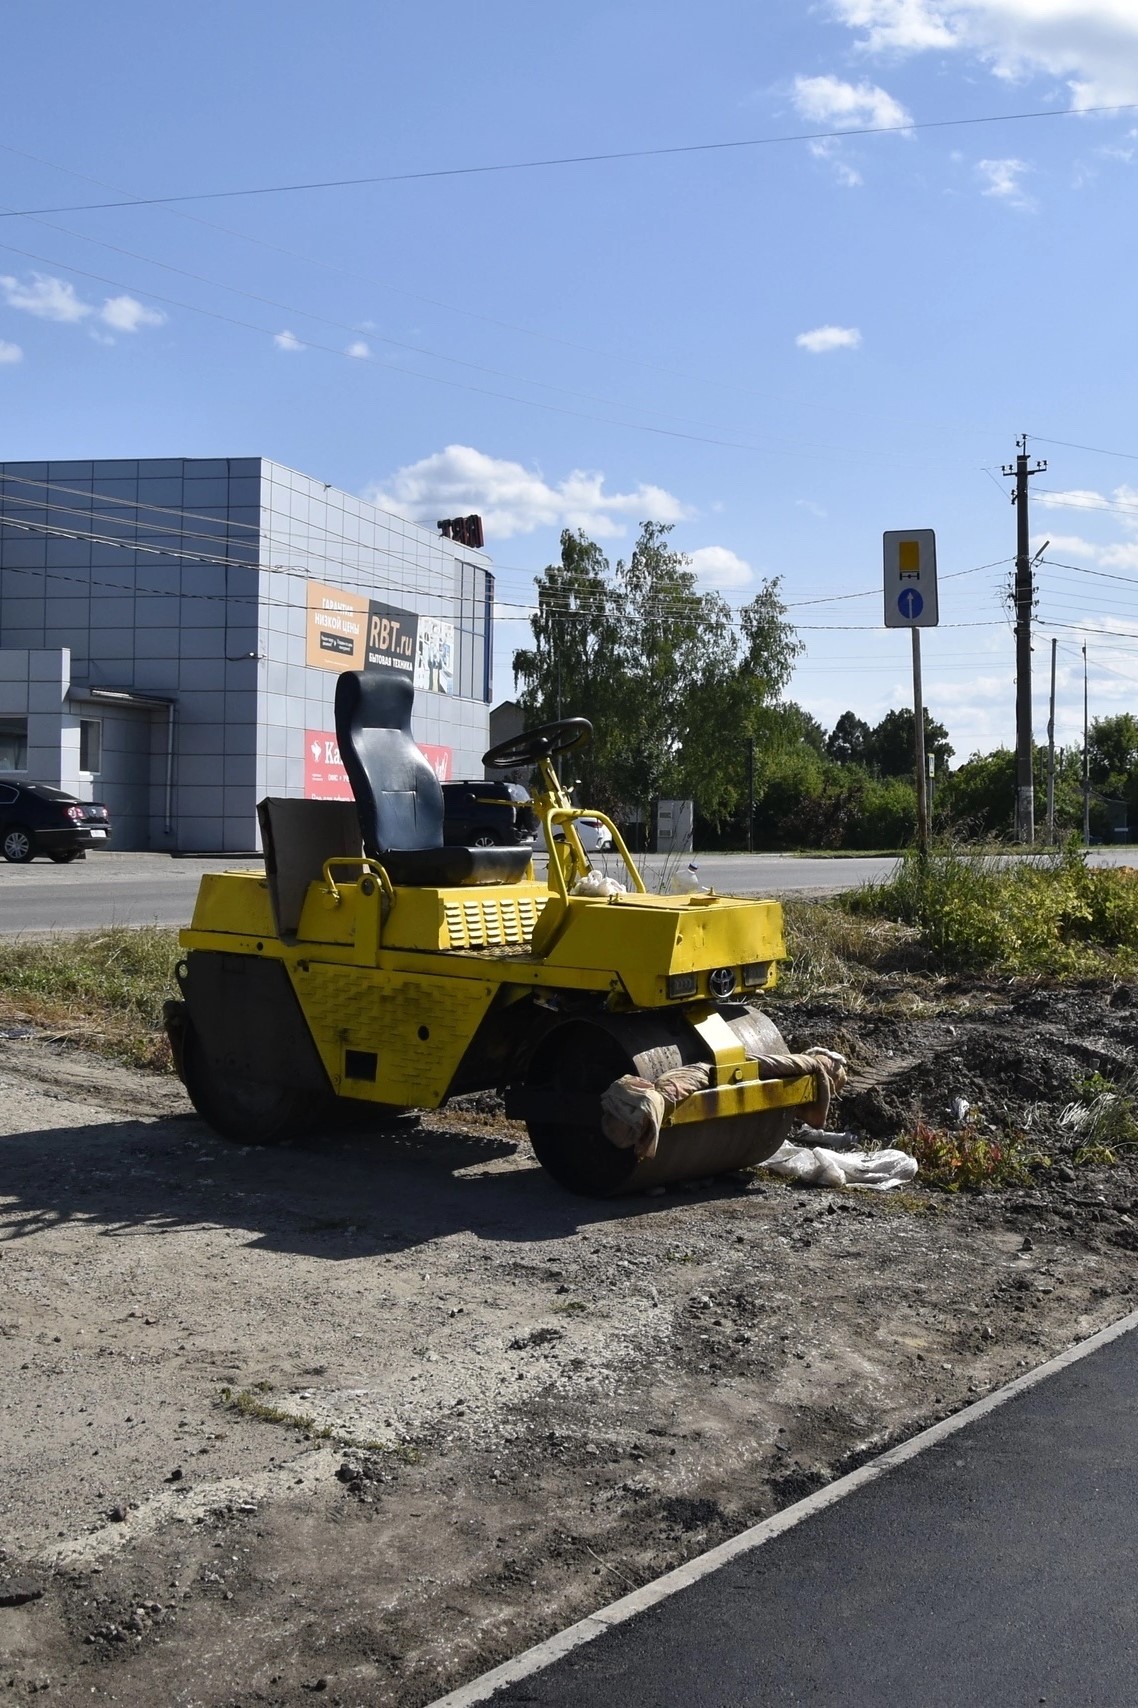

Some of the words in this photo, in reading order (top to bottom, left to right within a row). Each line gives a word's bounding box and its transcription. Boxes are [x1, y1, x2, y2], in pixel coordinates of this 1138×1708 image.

[322, 598, 353, 616] ГАРАНТИЯ
[315, 613, 341, 629] НИЗКОЙ
[342, 619, 360, 635] ЦЕНЫ
[369, 616, 412, 656] RBT.ru
[369, 652, 391, 666] БЫТОВАЯ
[392, 657, 413, 671] ТЕХНИКА
